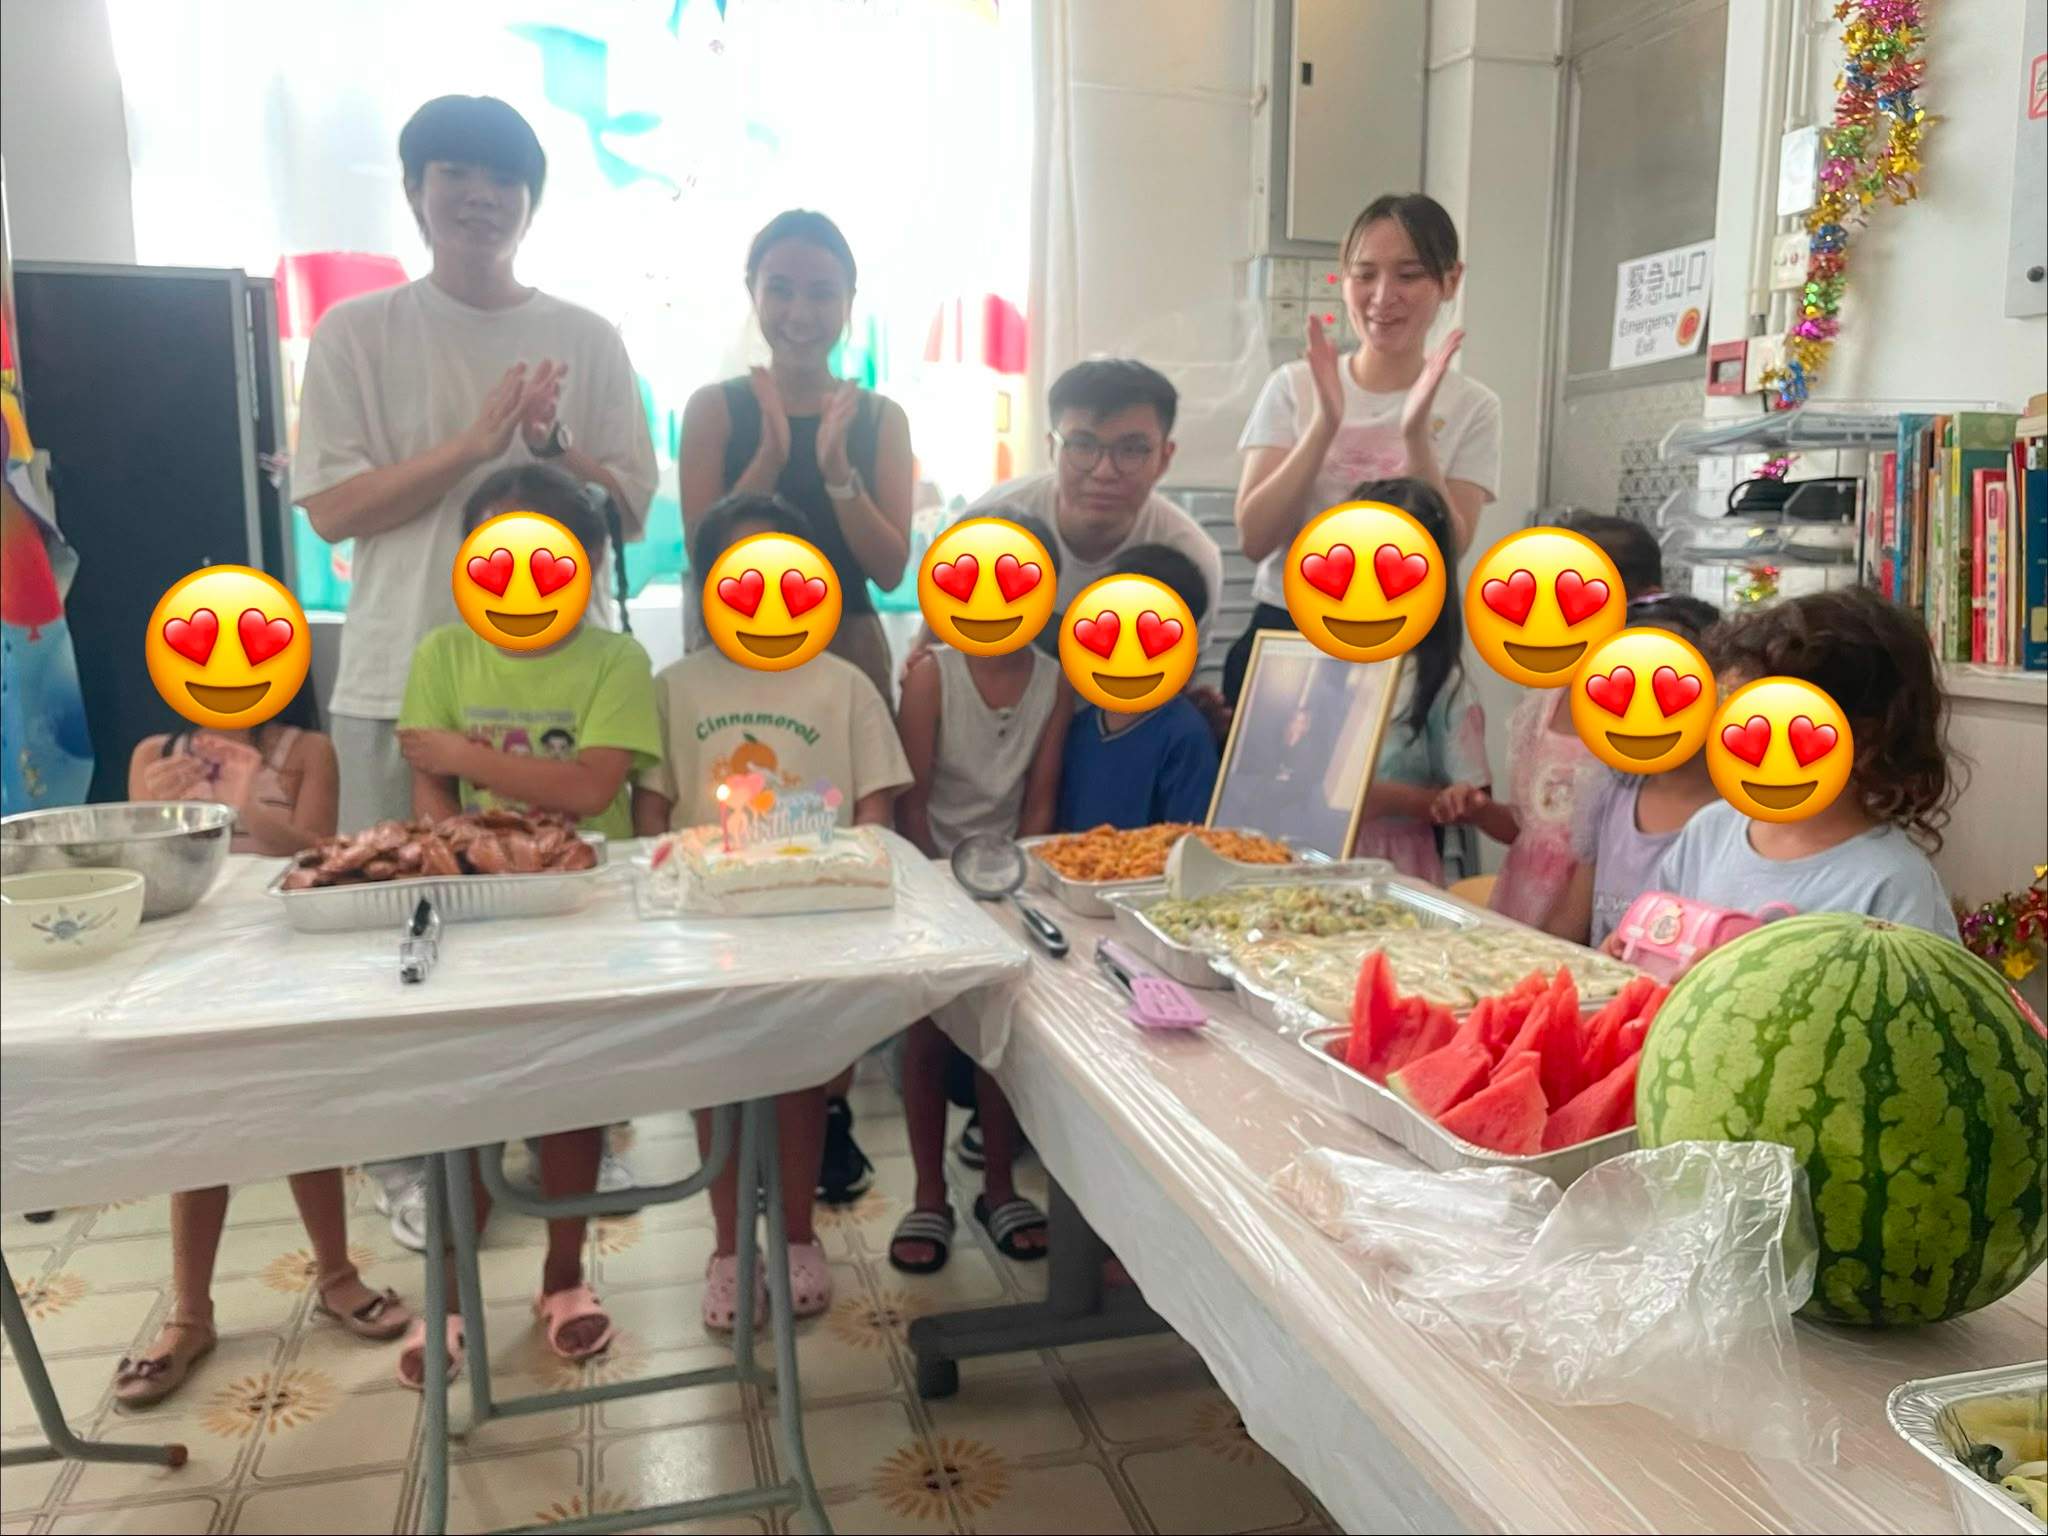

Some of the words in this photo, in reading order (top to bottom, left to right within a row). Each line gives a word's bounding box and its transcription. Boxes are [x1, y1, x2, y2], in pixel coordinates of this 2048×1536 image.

[1626, 250, 1706, 311] 緊急出口
[1619, 313, 1677, 338] Emergency
[1634, 338, 1656, 357] Exit
[695, 712, 821, 747] Cinnamoroll
